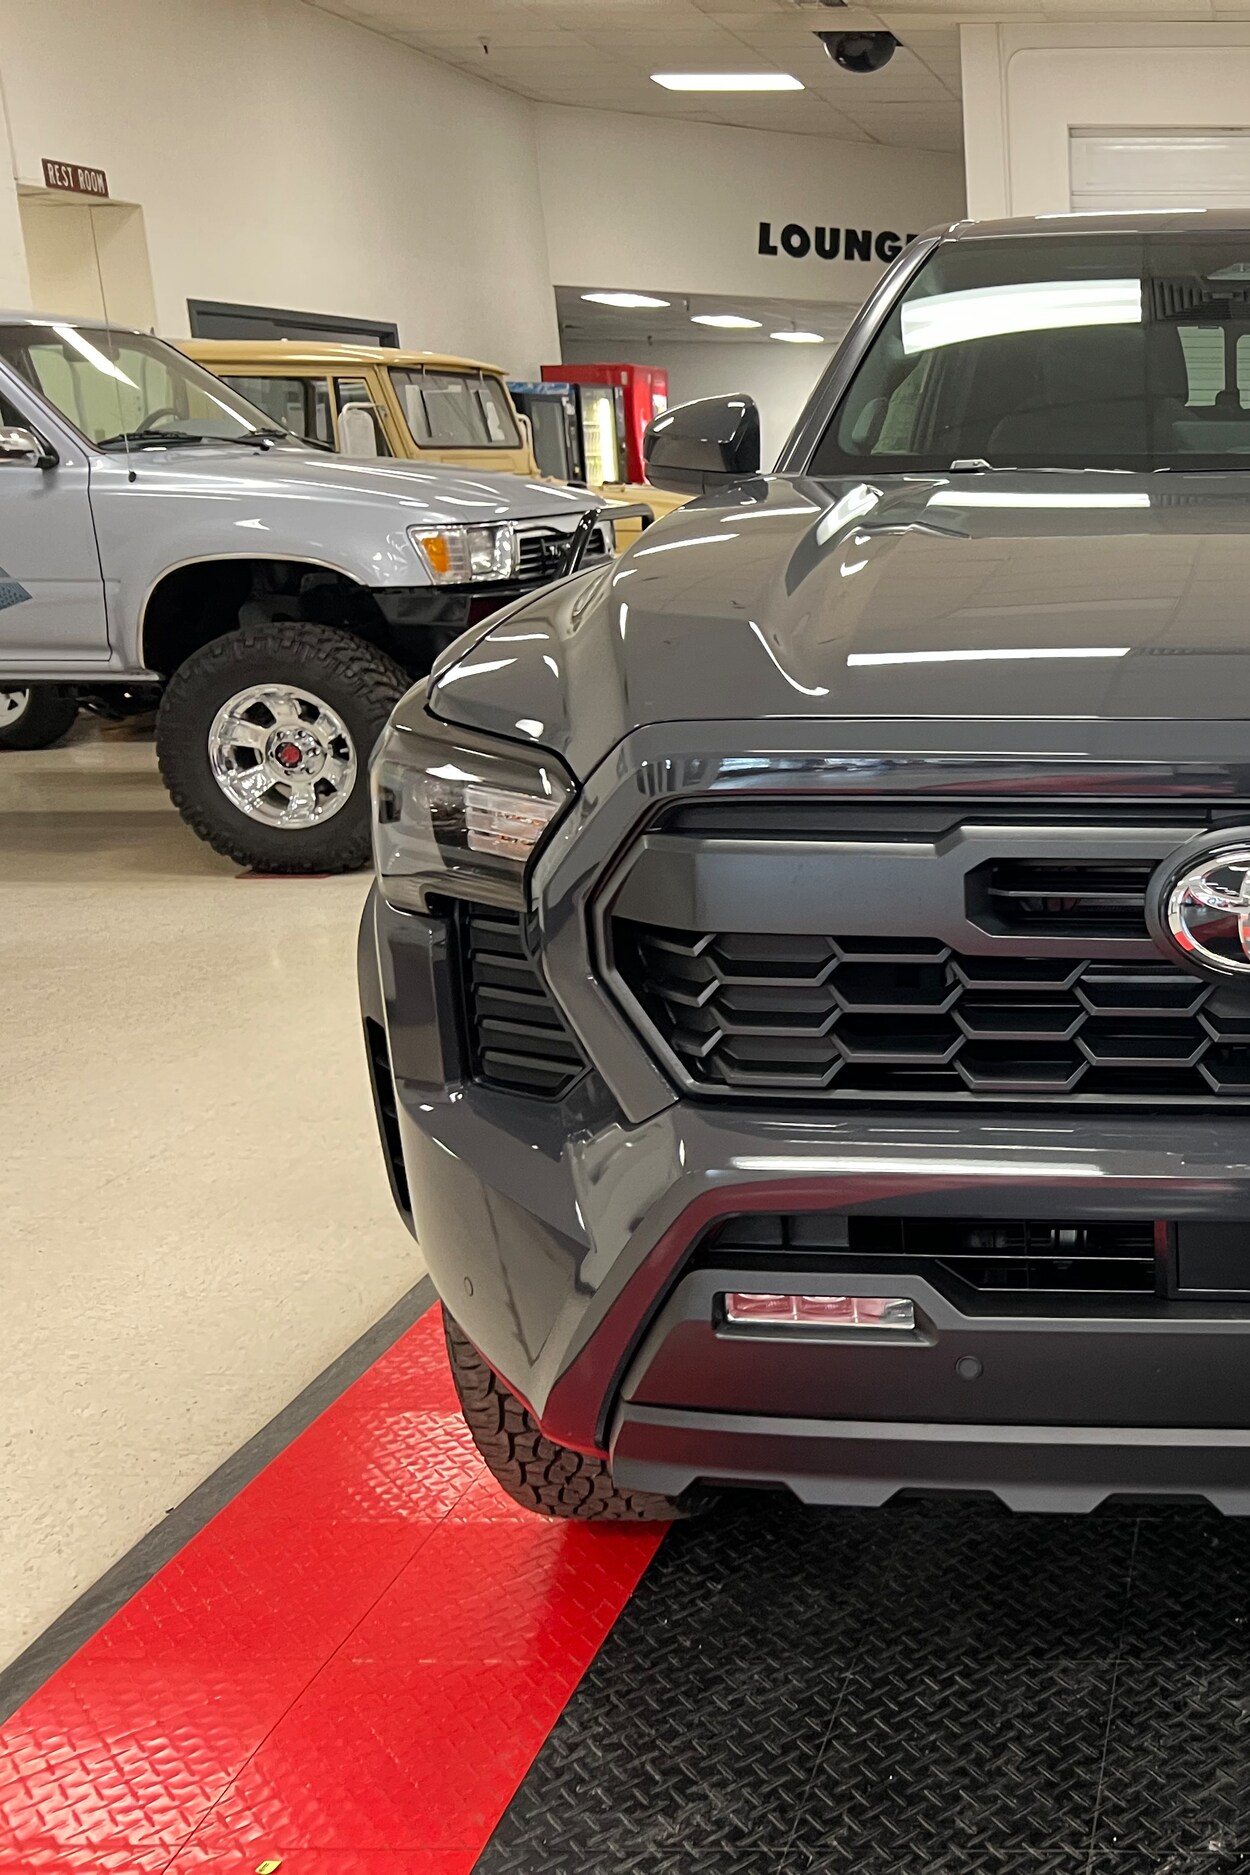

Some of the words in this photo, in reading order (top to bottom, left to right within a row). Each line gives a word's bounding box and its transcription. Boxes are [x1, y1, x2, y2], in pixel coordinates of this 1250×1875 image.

[47, 163, 74, 188] REST
[77, 168, 106, 194] ROOM
[758, 222, 919, 263] LOUNG
